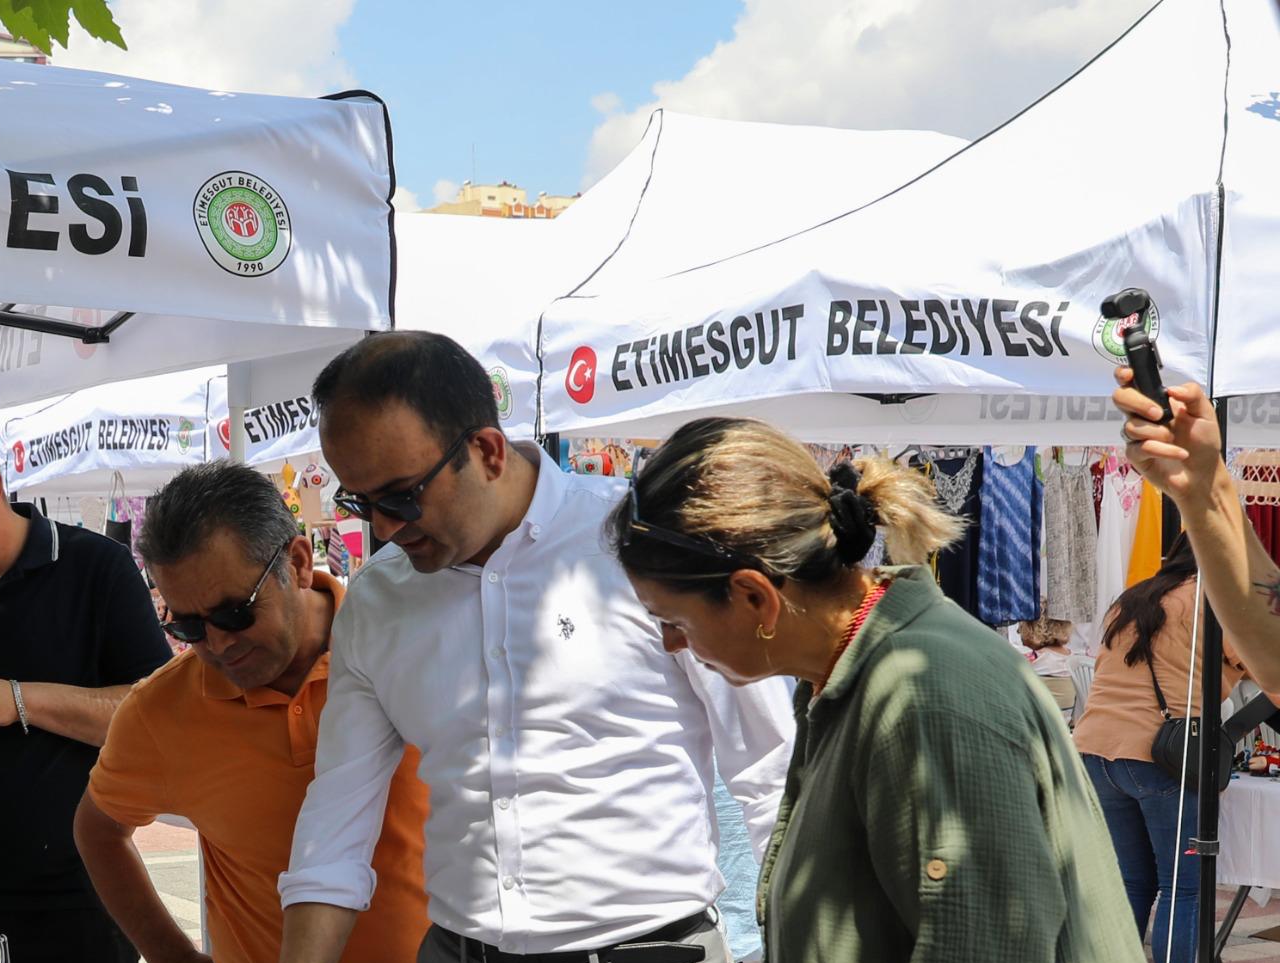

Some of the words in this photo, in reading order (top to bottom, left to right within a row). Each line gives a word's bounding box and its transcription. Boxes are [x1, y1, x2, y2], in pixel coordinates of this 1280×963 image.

[196, 176, 233, 227] ETİMESGUT
[238, 176, 289, 231] BELEDİYESİ
[236, 261, 264, 273] 1990
[611, 303, 805, 392] ETİMESGUT
[825, 299, 1070, 358] BELEDİYESİ
[29, 421, 93, 467] ETİMESGUT
[97, 418, 171, 451] BELEDİYESİ
